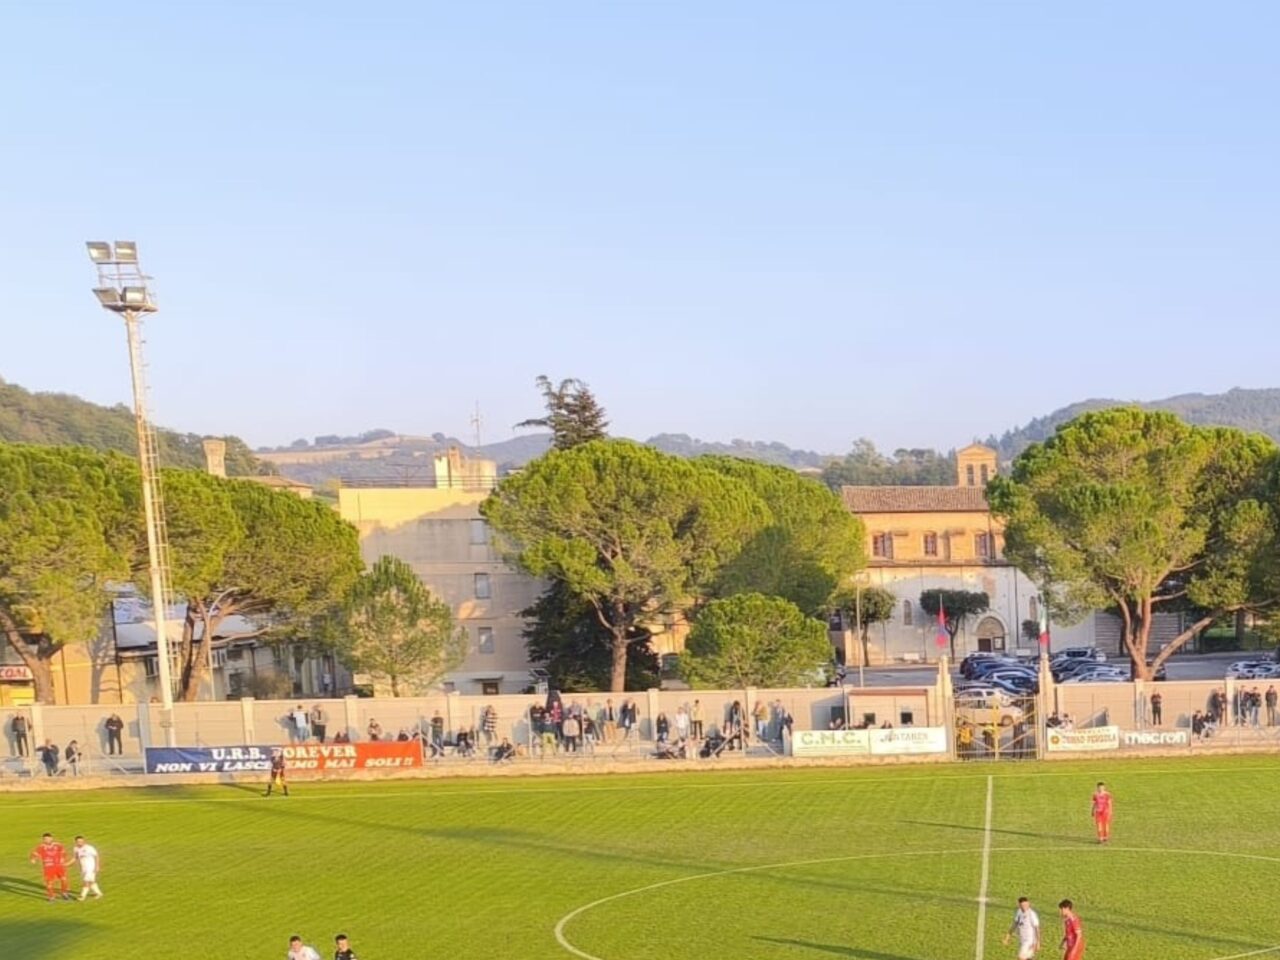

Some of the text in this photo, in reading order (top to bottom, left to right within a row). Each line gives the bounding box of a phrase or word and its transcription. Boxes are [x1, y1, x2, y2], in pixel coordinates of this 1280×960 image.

[801, 731, 862, 746] C.M.C.
[1124, 731, 1187, 745] macron
[212, 747, 267, 760] U.R.B.
[155, 762, 193, 773] NON
[198, 762, 218, 772] VI
[223, 760, 319, 771] LASCEMO
[324, 758, 356, 769] MAI
